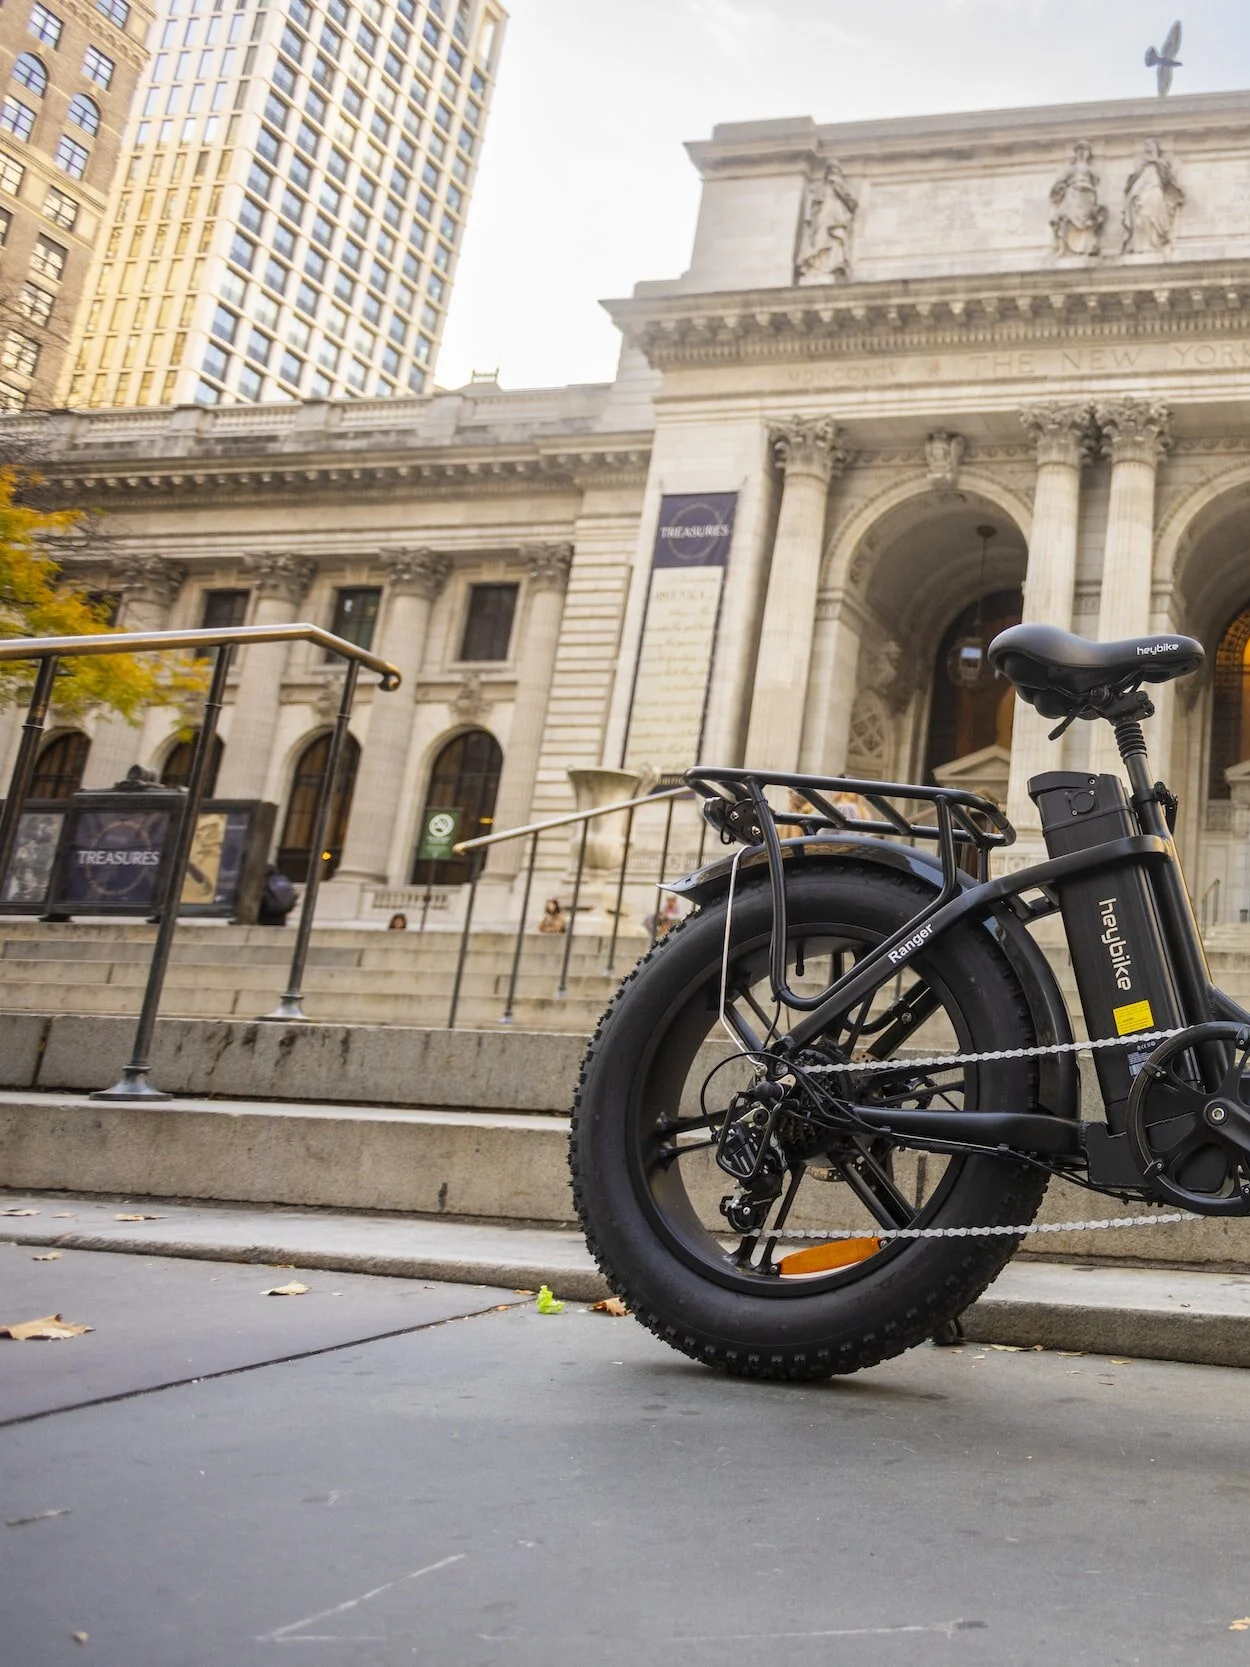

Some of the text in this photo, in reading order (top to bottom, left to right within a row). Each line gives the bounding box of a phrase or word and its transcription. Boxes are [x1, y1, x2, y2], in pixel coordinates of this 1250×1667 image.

[970, 353, 1035, 378] THE
[1061, 348, 1142, 371] NEW
[660, 524, 730, 539] TREASURES
[1136, 643, 1179, 656] heybike
[77, 850, 161, 866] TREASURES
[887, 923, 934, 965] Ranger
[1098, 897, 1132, 992] heybike
